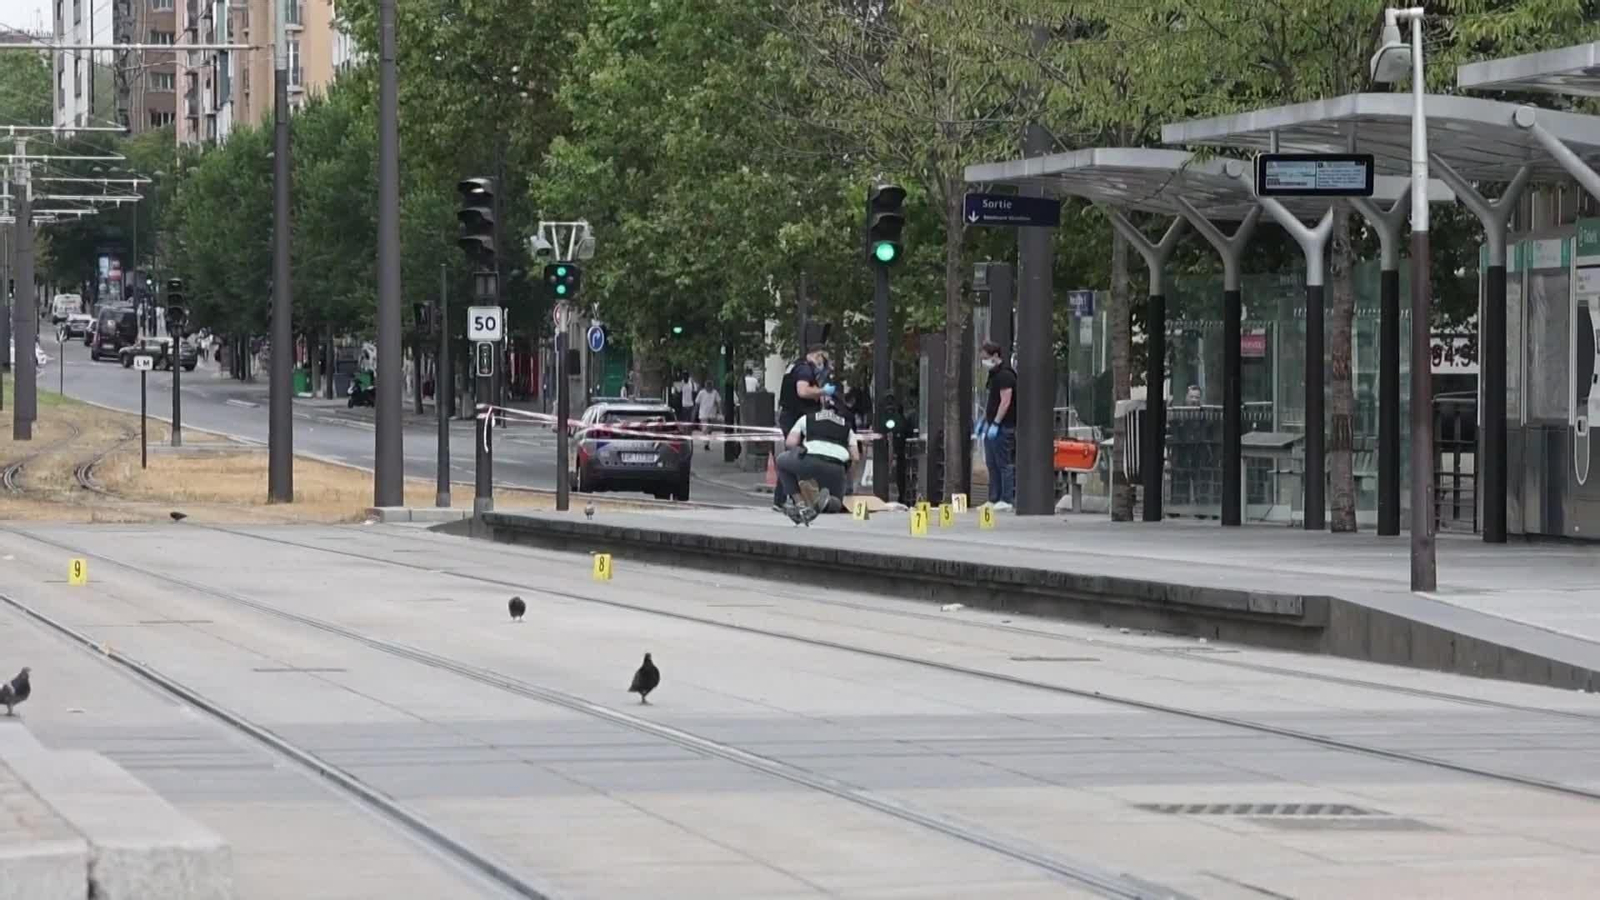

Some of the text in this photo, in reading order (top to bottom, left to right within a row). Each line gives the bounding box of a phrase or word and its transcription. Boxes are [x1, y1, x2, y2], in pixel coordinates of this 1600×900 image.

[982, 199, 1013, 209] Sortie
[474, 316, 496, 331] 50
[856, 502, 862, 516] 3
[944, 505, 950, 520] 5
[984, 507, 990, 522] 6
[916, 512, 921, 528] 7
[74, 560, 81, 578] 9
[598, 555, 605, 572] 8
